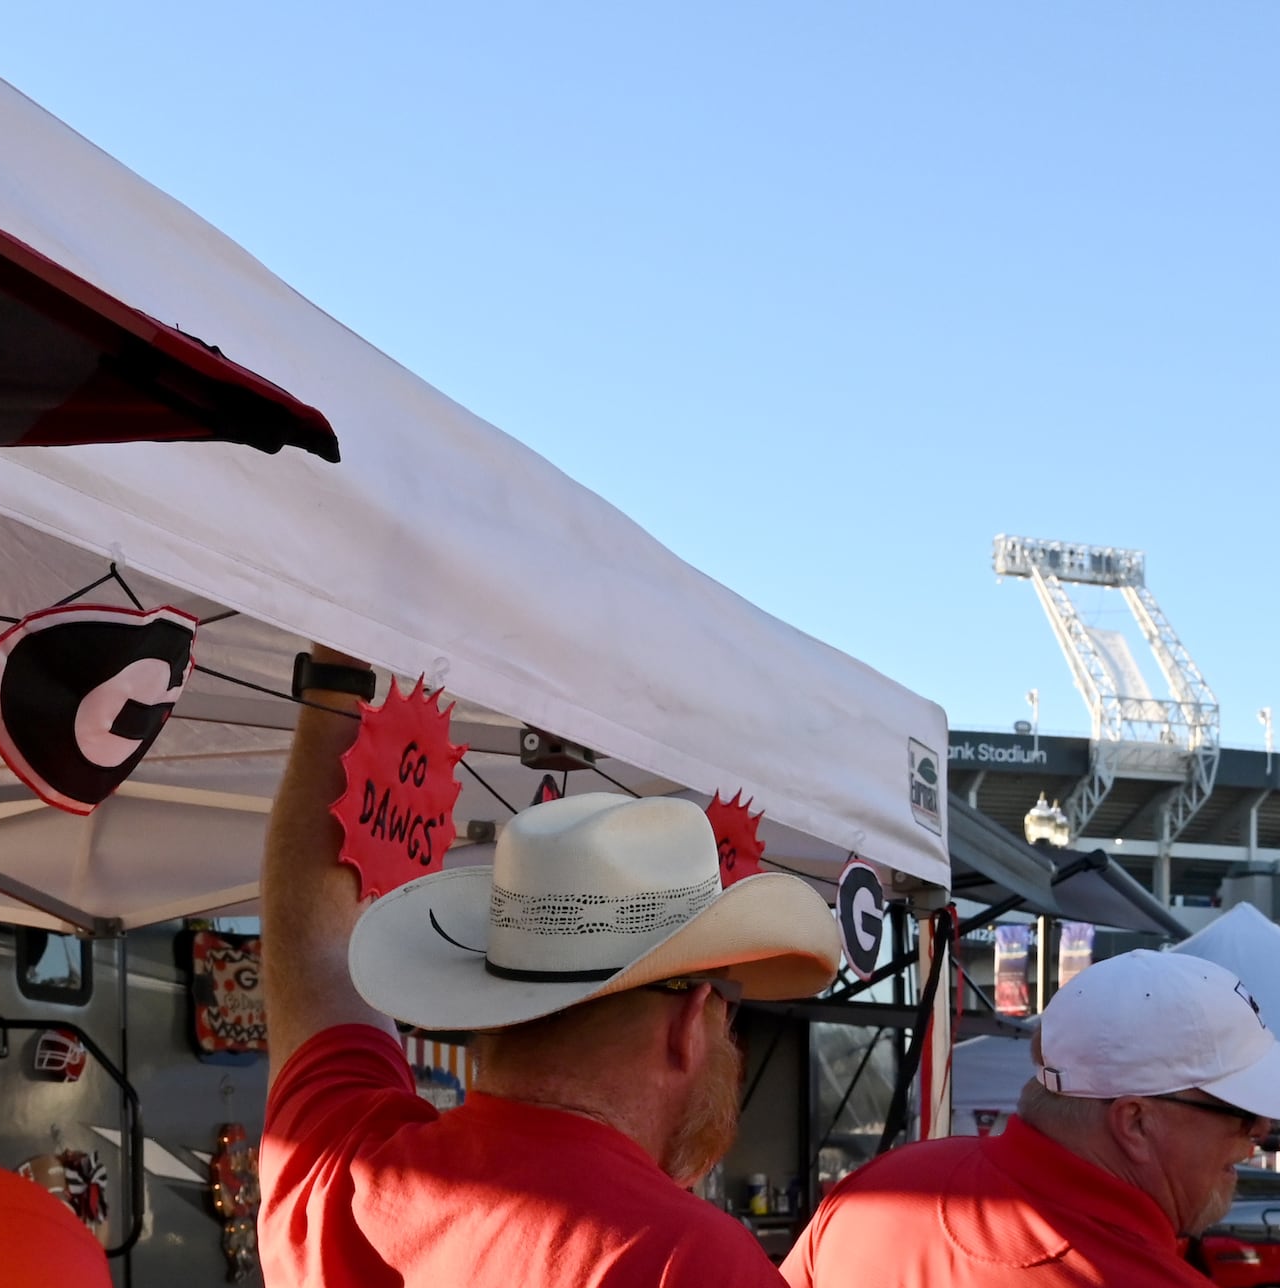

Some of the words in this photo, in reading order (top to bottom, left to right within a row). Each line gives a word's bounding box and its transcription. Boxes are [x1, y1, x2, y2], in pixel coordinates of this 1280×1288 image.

[399, 741, 428, 788] GO
[946, 741, 975, 761] ank
[977, 743, 1048, 765] Stadium
[838, 863, 885, 976] G
[234, 966, 259, 990] G
